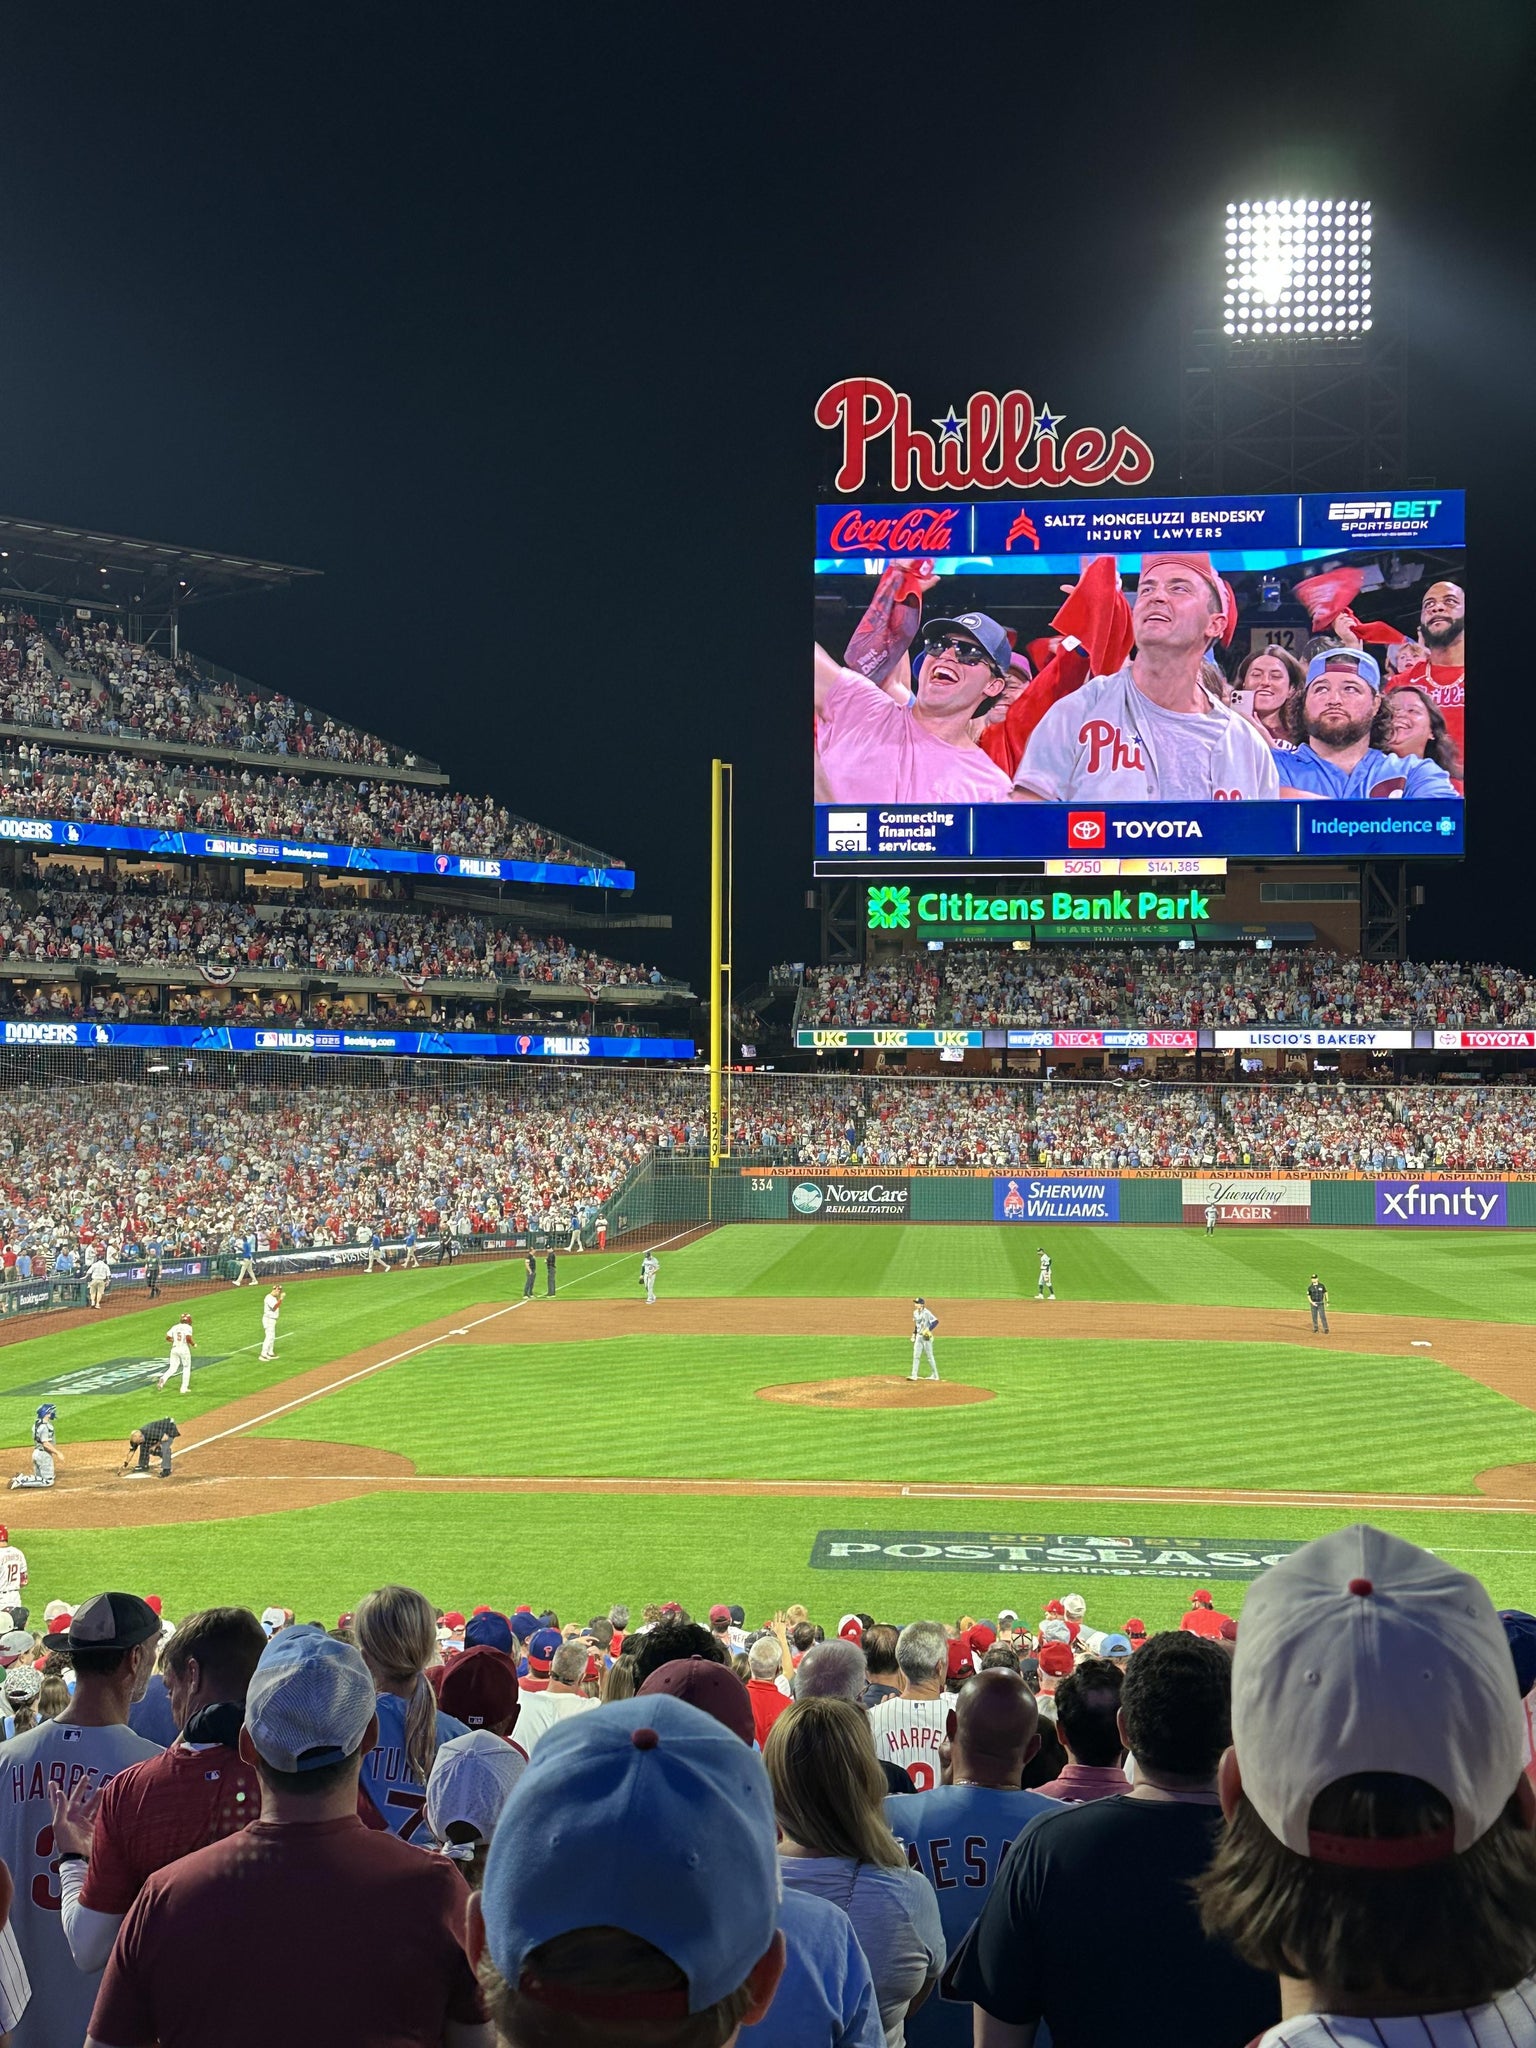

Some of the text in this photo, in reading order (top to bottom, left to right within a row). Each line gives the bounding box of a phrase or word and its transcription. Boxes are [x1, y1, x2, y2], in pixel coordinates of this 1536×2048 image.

[814, 377, 1155, 493] Phillies
[1328, 500, 1442, 520] ESPN BET
[1044, 510, 1266, 527] SALTZ MONGELUZZI BENDESKY
[1341, 520, 1429, 531] SPORTSBOOK
[830, 509, 960, 552] Coca-Cola
[1087, 527, 1223, 541] INJURY LAWYERS
[878, 811, 954, 826] Connecting
[0, 819, 53, 840] ODGERS
[878, 825, 936, 838] financial
[1112, 820, 1203, 839] TOYOTA
[1311, 817, 1433, 837] Independence
[226, 841, 257, 855] NLDS
[878, 839, 937, 852] services.
[459, 859, 501, 877] PHILLIES
[1148, 861, 1200, 873] $141,385
[917, 889, 1210, 921] Citizens Bank Park
[1056, 925, 1115, 934] HARRY
[5, 1023, 78, 1044] DODGERS
[279, 1033, 315, 1047] NLDS
[343, 1036, 396, 1048] Booking.com
[813, 1031, 969, 1046] UKG UKG UKG
[1058, 1032, 1100, 1046] NECA
[1152, 1032, 1193, 1046] NECA
[1250, 1033, 1376, 1045] LISCIO'S BAKERY
[1466, 1032, 1528, 1047] TOYOTA
[543, 1037, 590, 1055] PHILLIES
[770, 1167, 831, 1176] ASPLUNDH
[842, 1167, 903, 1176] ASPLUNDH
[915, 1168, 976, 1177] ASPLUNDH
[988, 1169, 1049, 1178] ASPLUNDH
[1061, 1170, 1123, 1178] ASPLUNDH
[1135, 1170, 1197, 1179] ASPLUNDH
[1438, 1173, 1503, 1181] ASPLUNDH
[751, 1178, 773, 1191] 334
[1028, 1182, 1105, 1199] SHERWIN
[826, 1184, 907, 1203] NovaCare
[1206, 1182, 1287, 1204] Yuengling
[826, 1205, 905, 1214] REHABILITATION
[1383, 1184, 1499, 1220] xfinity
[1220, 1207, 1272, 1219] LAGER
[7, 1563, 19, 1582] 12
[999, 1564, 1212, 1577] Booking.com
[886, 1727, 949, 1753] HARPE
[12, 1761, 115, 1804] HARPE
